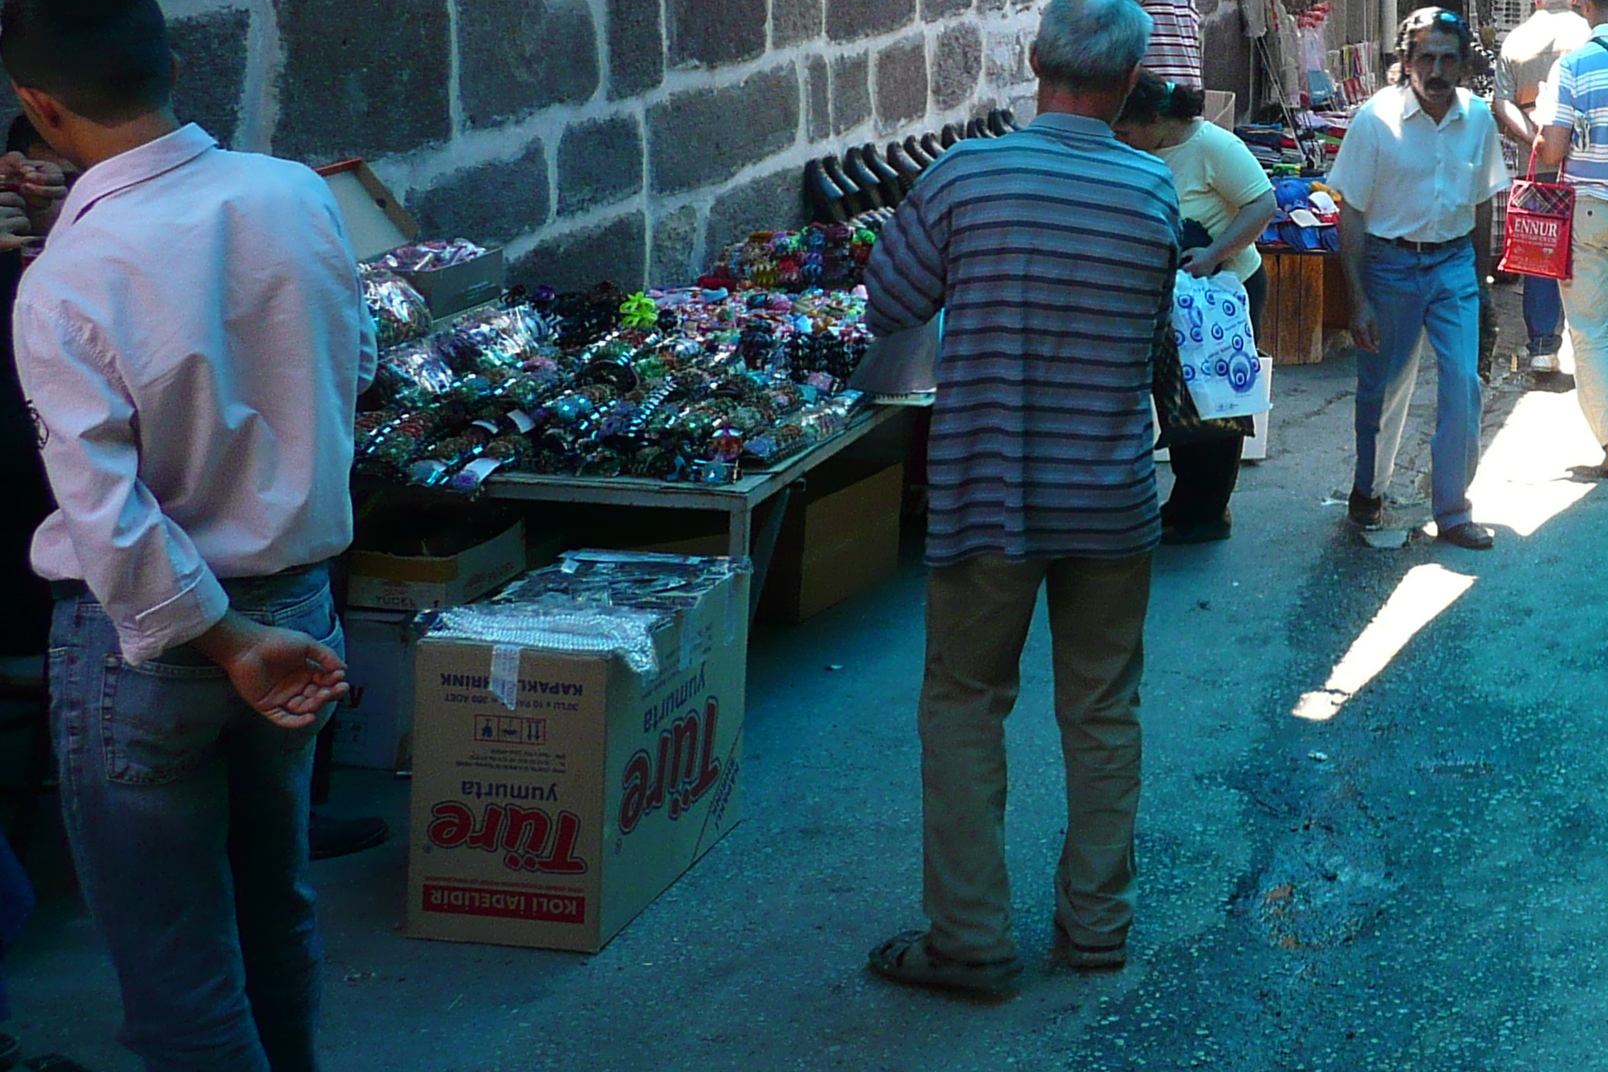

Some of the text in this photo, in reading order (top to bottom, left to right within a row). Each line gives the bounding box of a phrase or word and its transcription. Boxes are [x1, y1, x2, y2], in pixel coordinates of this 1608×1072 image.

[1514, 217, 1558, 238] ENNUR
[643, 660, 707, 733] yumurta
[619, 695, 721, 835] Türe
[461, 780, 558, 802] yumurta
[428, 800, 588, 875] Türe
[431, 889, 578, 916] KOLİ İADELİDİR
